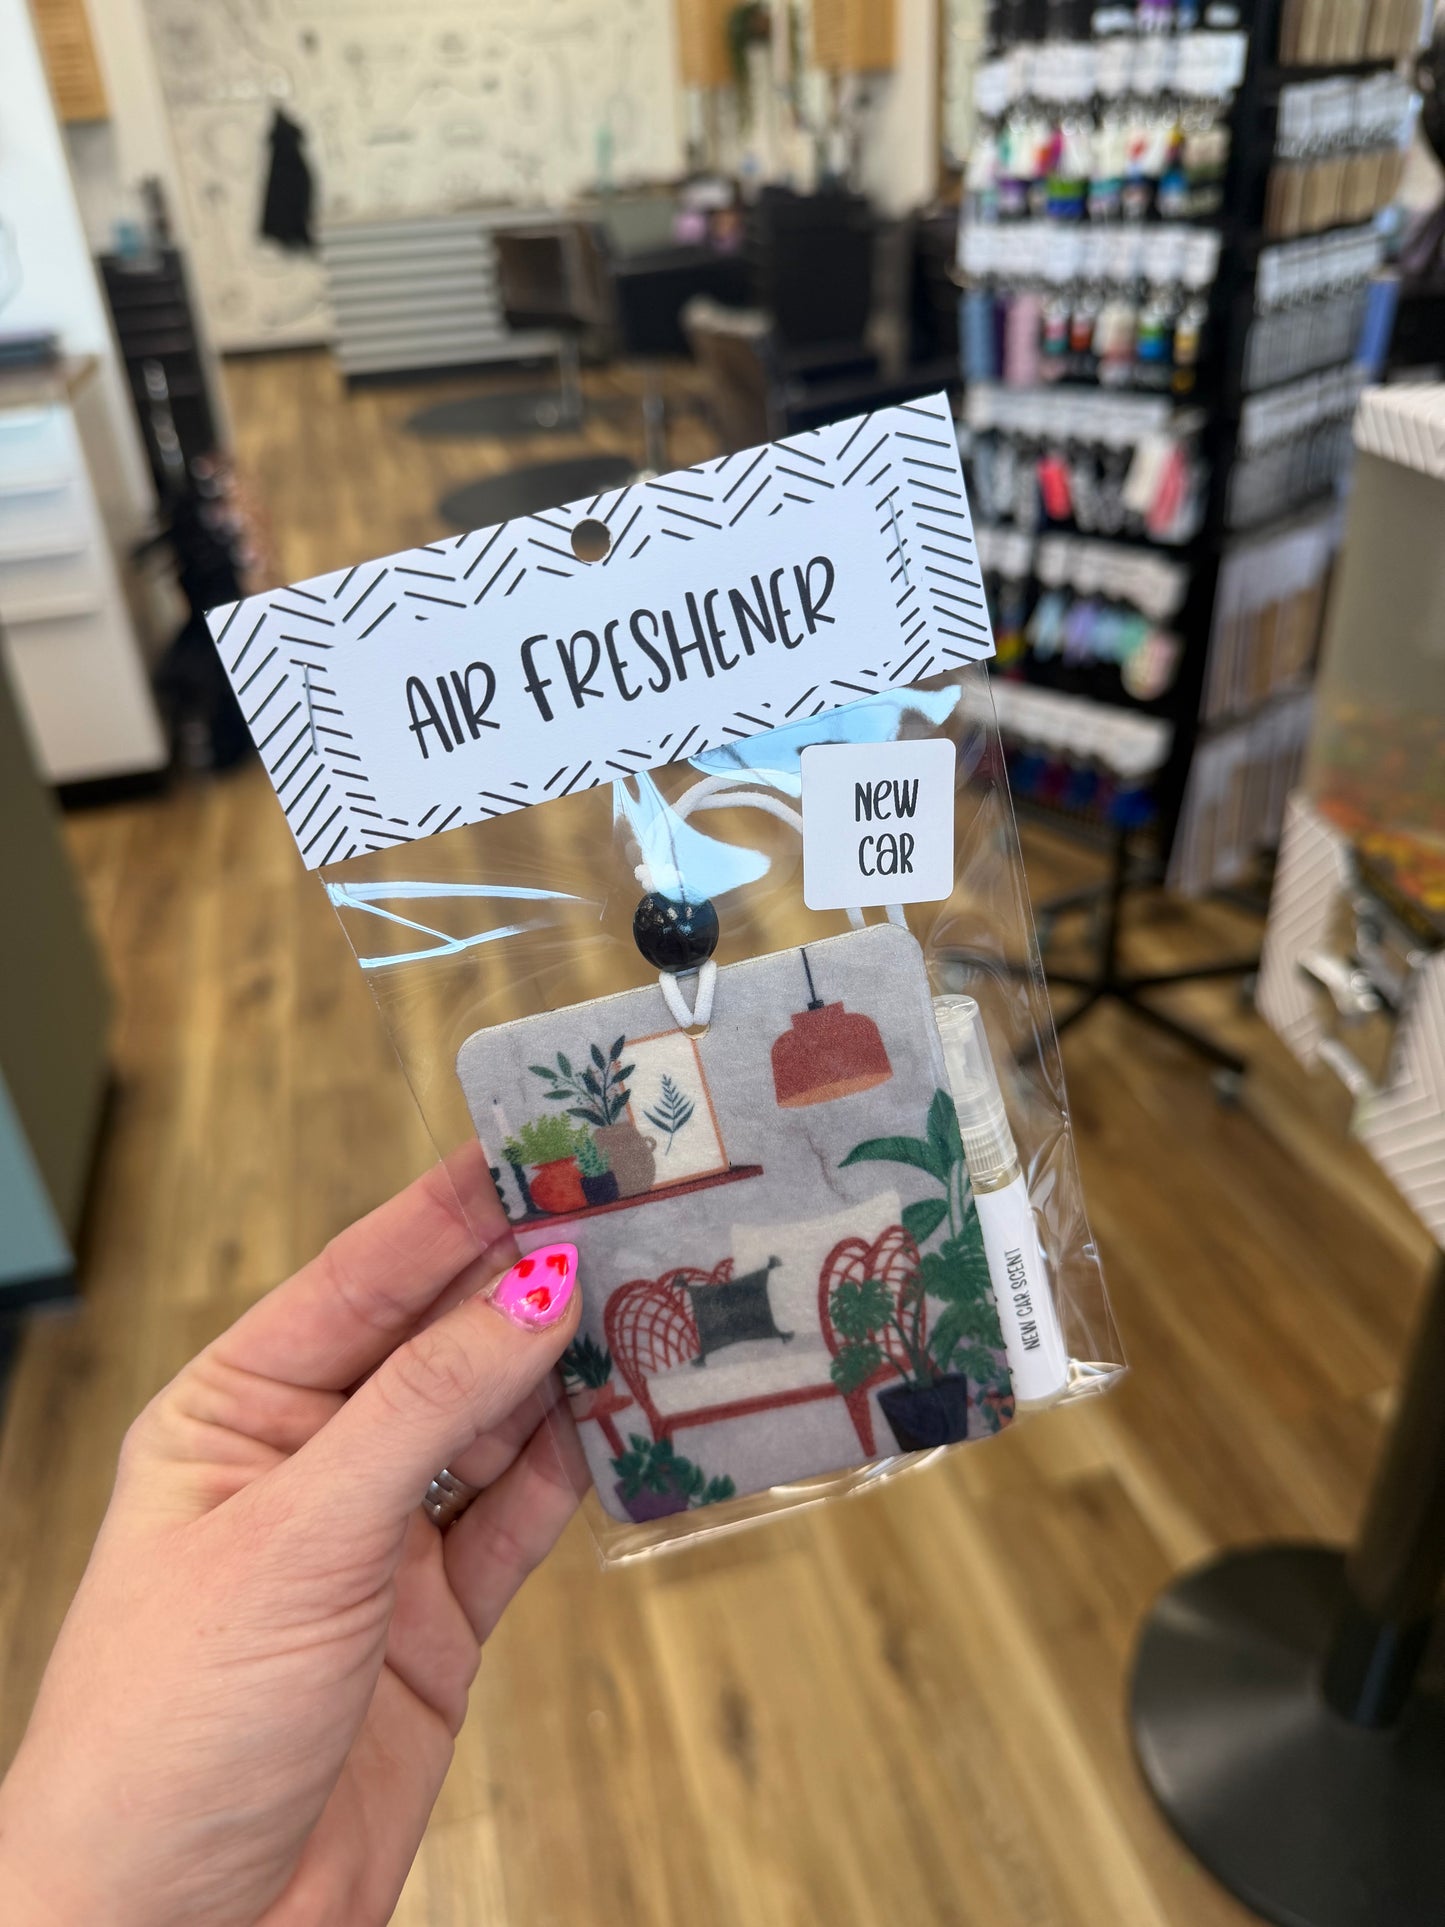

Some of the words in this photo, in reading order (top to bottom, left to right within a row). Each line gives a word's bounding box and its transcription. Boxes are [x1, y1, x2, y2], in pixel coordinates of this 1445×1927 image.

[405, 661, 501, 760] AIR
[520, 555, 836, 723] FRESHENER
[1004, 1247, 1028, 1290] SCENT
[1013, 1290, 1033, 1317] CAR
[1018, 1319, 1041, 1351] NEW
